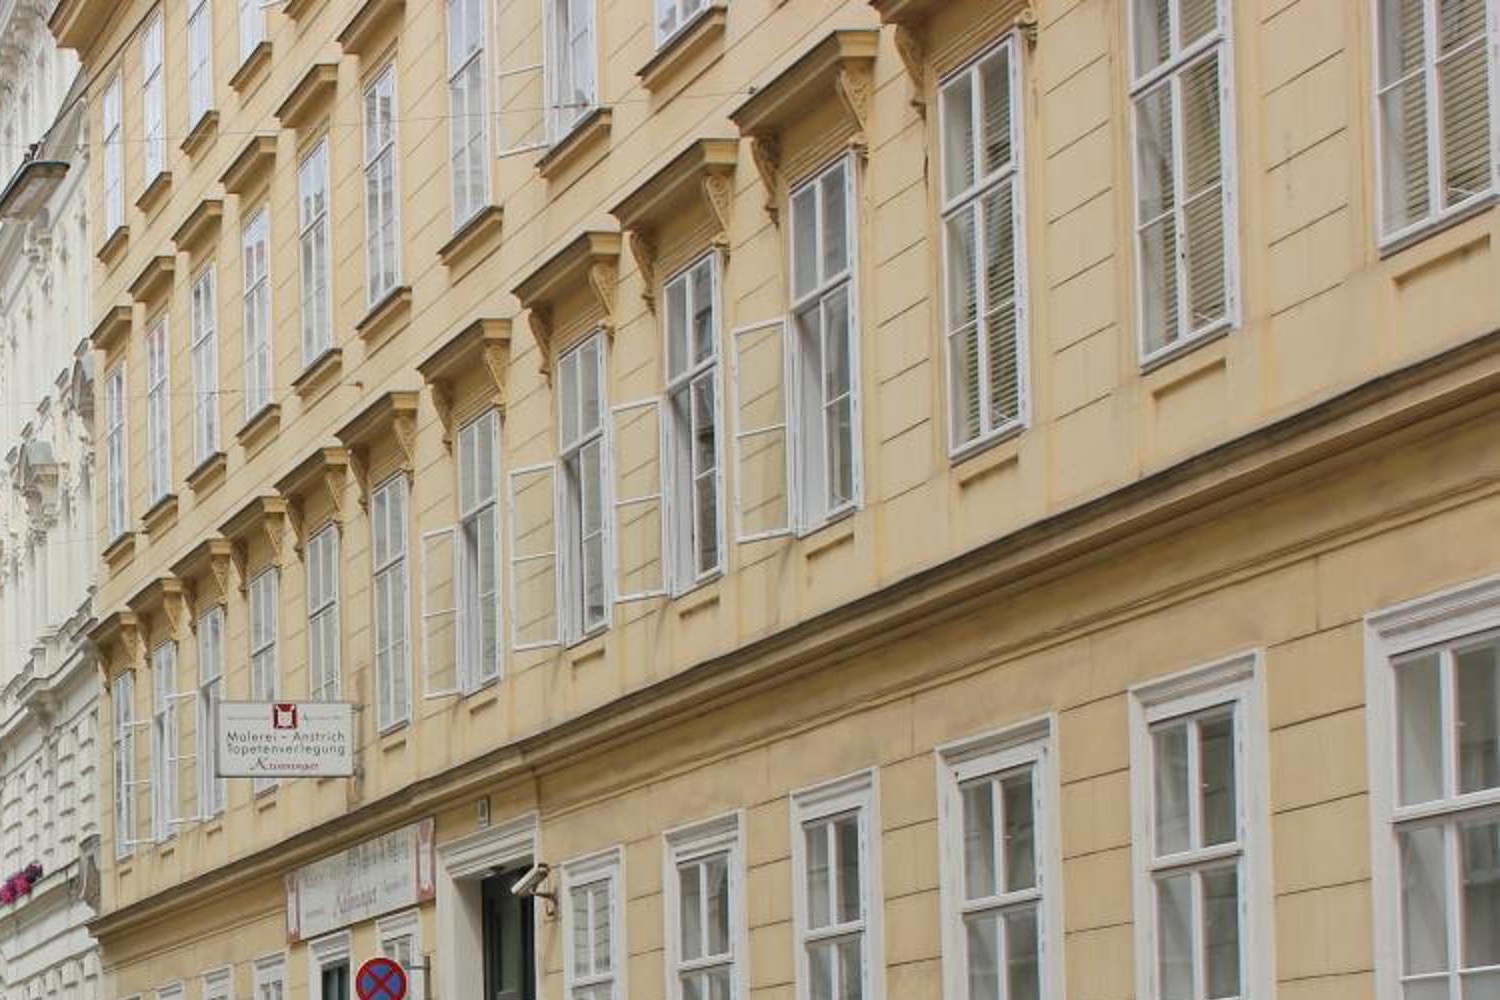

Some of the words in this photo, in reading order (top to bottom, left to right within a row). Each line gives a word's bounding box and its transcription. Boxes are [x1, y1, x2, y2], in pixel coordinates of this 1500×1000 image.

[226, 731, 277, 743] Malerei
[291, 731, 346, 743] Anstrich
[226, 743, 346, 757] Tapetenverlegung
